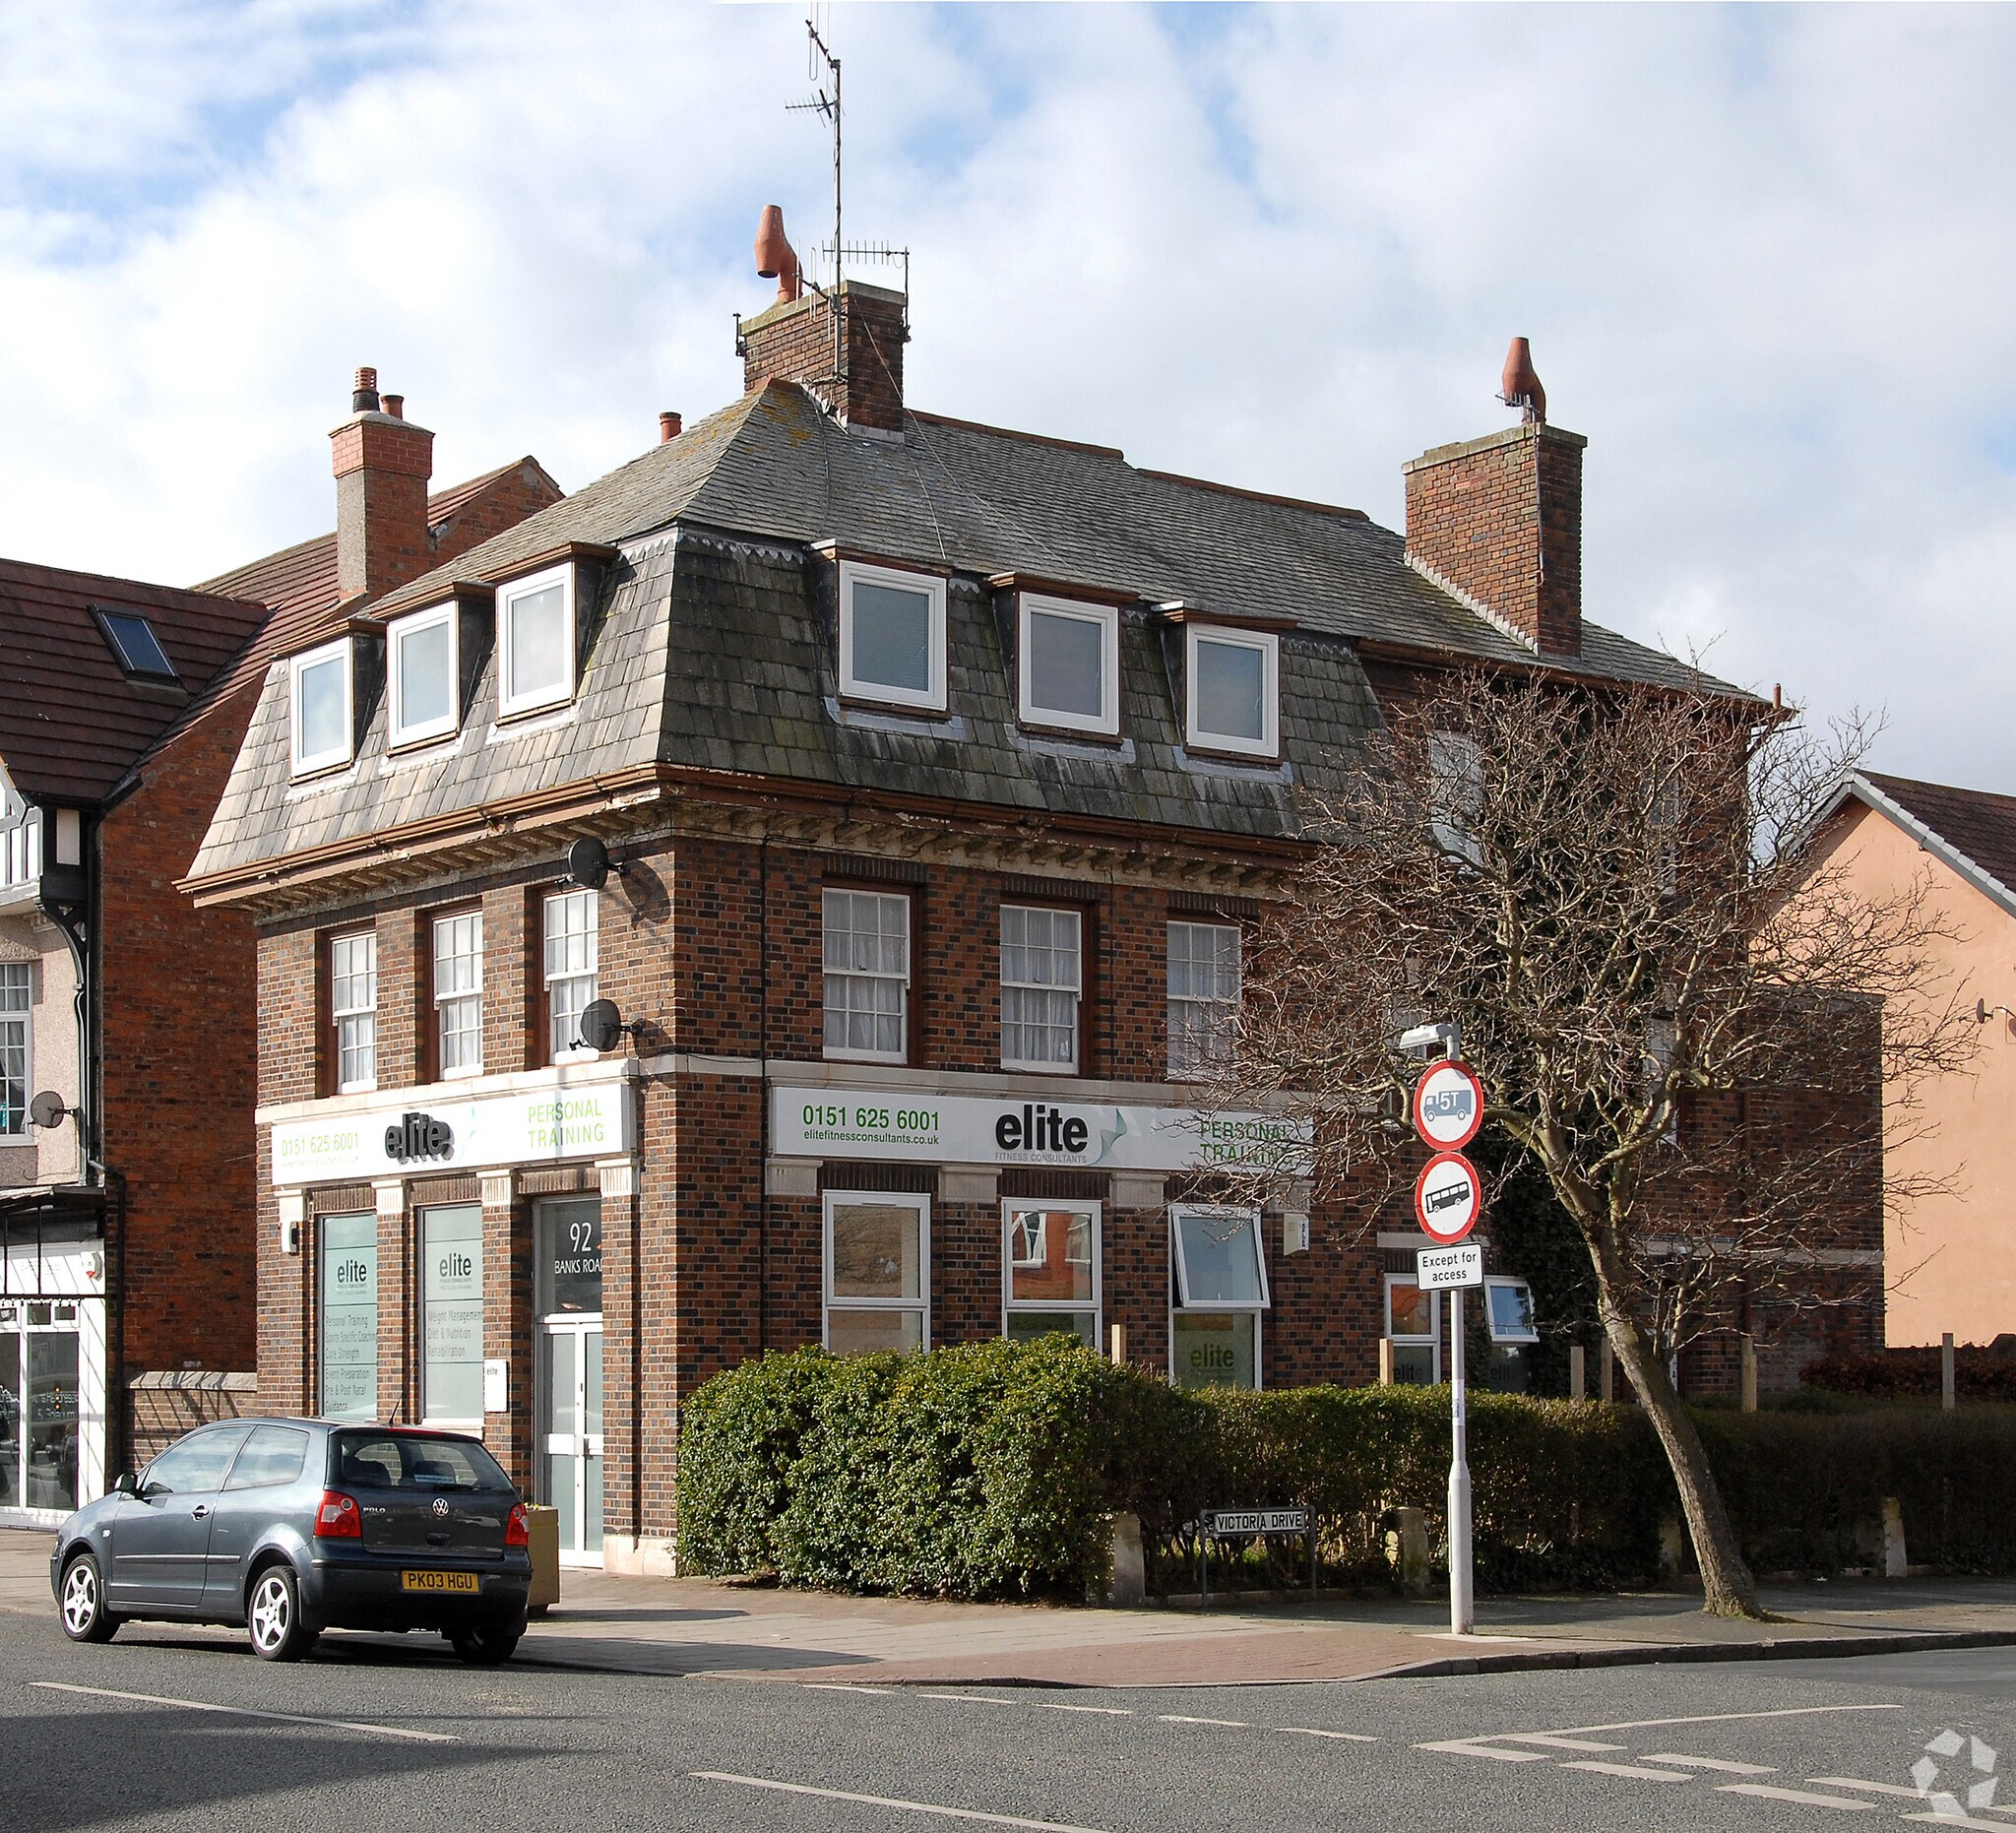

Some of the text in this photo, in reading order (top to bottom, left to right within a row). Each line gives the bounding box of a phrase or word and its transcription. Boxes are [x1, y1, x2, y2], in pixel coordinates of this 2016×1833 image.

[529, 1099, 602, 1123] PERSONAL
[802, 1105, 939, 1131] 0151 625 6001
[385, 1113, 453, 1160] elite
[529, 1123, 604, 1148] TRAINING
[803, 1129, 939, 1145] elitefitnessconsultants.co.uk
[995, 1104, 1088, 1153] elite
[282, 1131, 359, 1157] 0151 625 6001
[994, 1152, 1087, 1163] FITNESS CONSULTANTS
[569, 1222, 592, 1252] 92
[337, 1259, 367, 1283] elite
[439, 1252, 472, 1277] elite
[554, 1259, 581, 1274] BANKS
[1422, 1252, 1477, 1268] Except for
[1432, 1270, 1467, 1282] access
[347, 1314, 368, 1328] Training
[1191, 1343, 1234, 1366] elite
[1218, 1513, 1303, 1530] VICTORIA DRIVE
[408, 1572, 473, 1589] PK03 HGU
